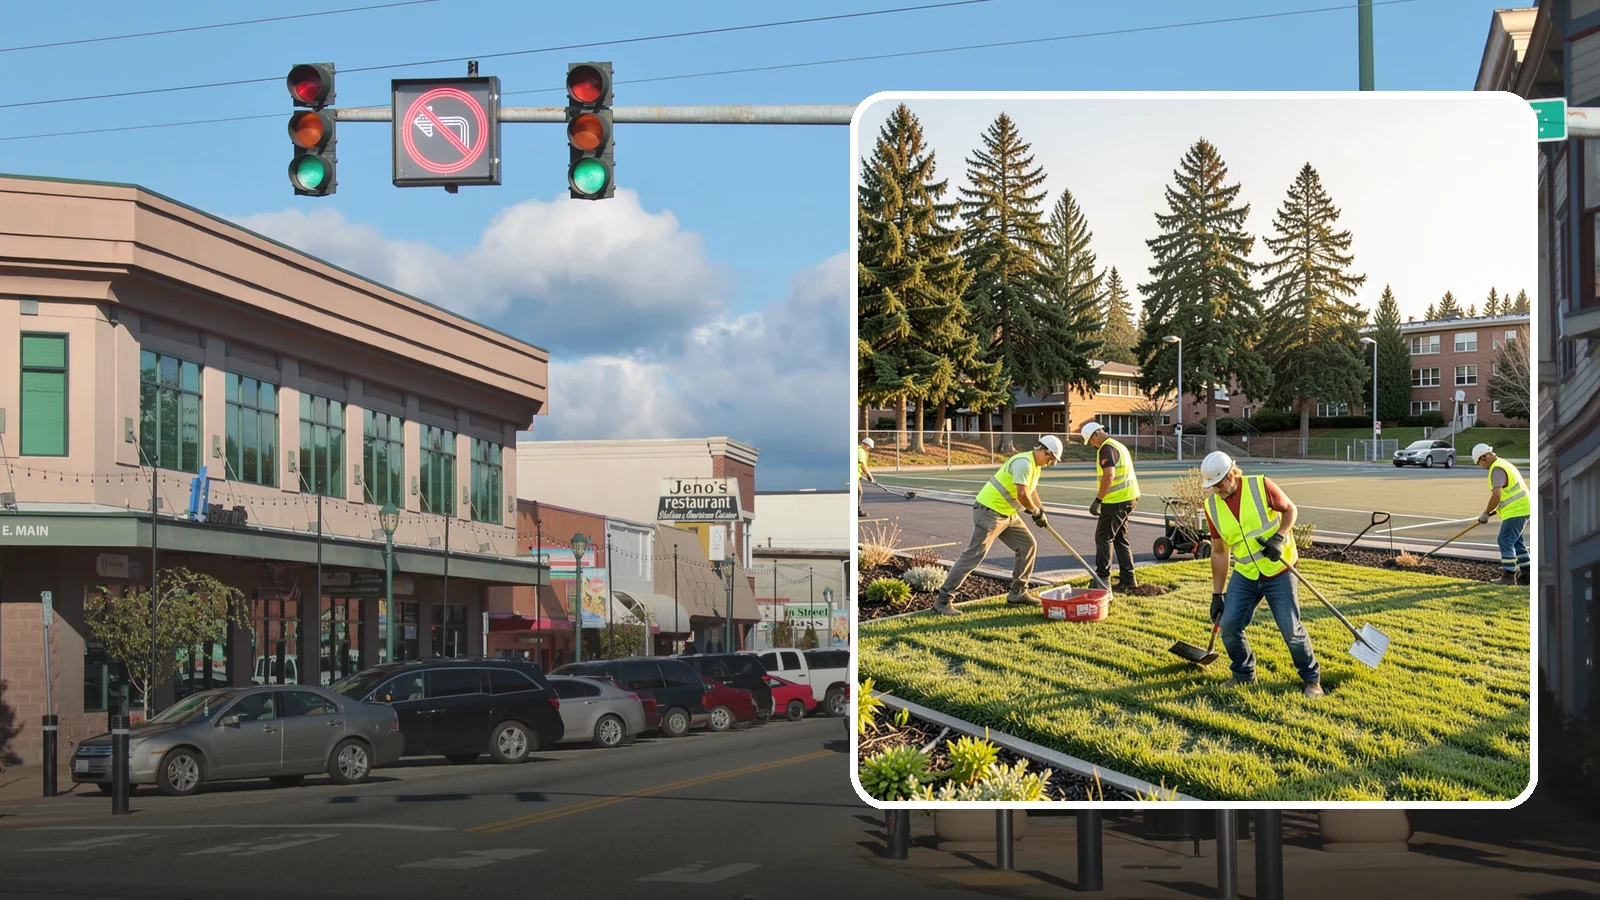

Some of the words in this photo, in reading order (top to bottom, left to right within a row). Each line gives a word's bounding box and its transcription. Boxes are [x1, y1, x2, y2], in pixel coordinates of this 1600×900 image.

[669, 480, 727, 495] Jeno's
[665, 496, 731, 509] restaurant
[658, 510, 681, 520] Italian
[686, 510, 714, 519] American
[715, 510, 737, 519] Cuisine
[2, 525, 13, 536] E.
[15, 525, 49, 536] MAIN
[797, 608, 829, 617] Street
[790, 619, 824, 627] lass
